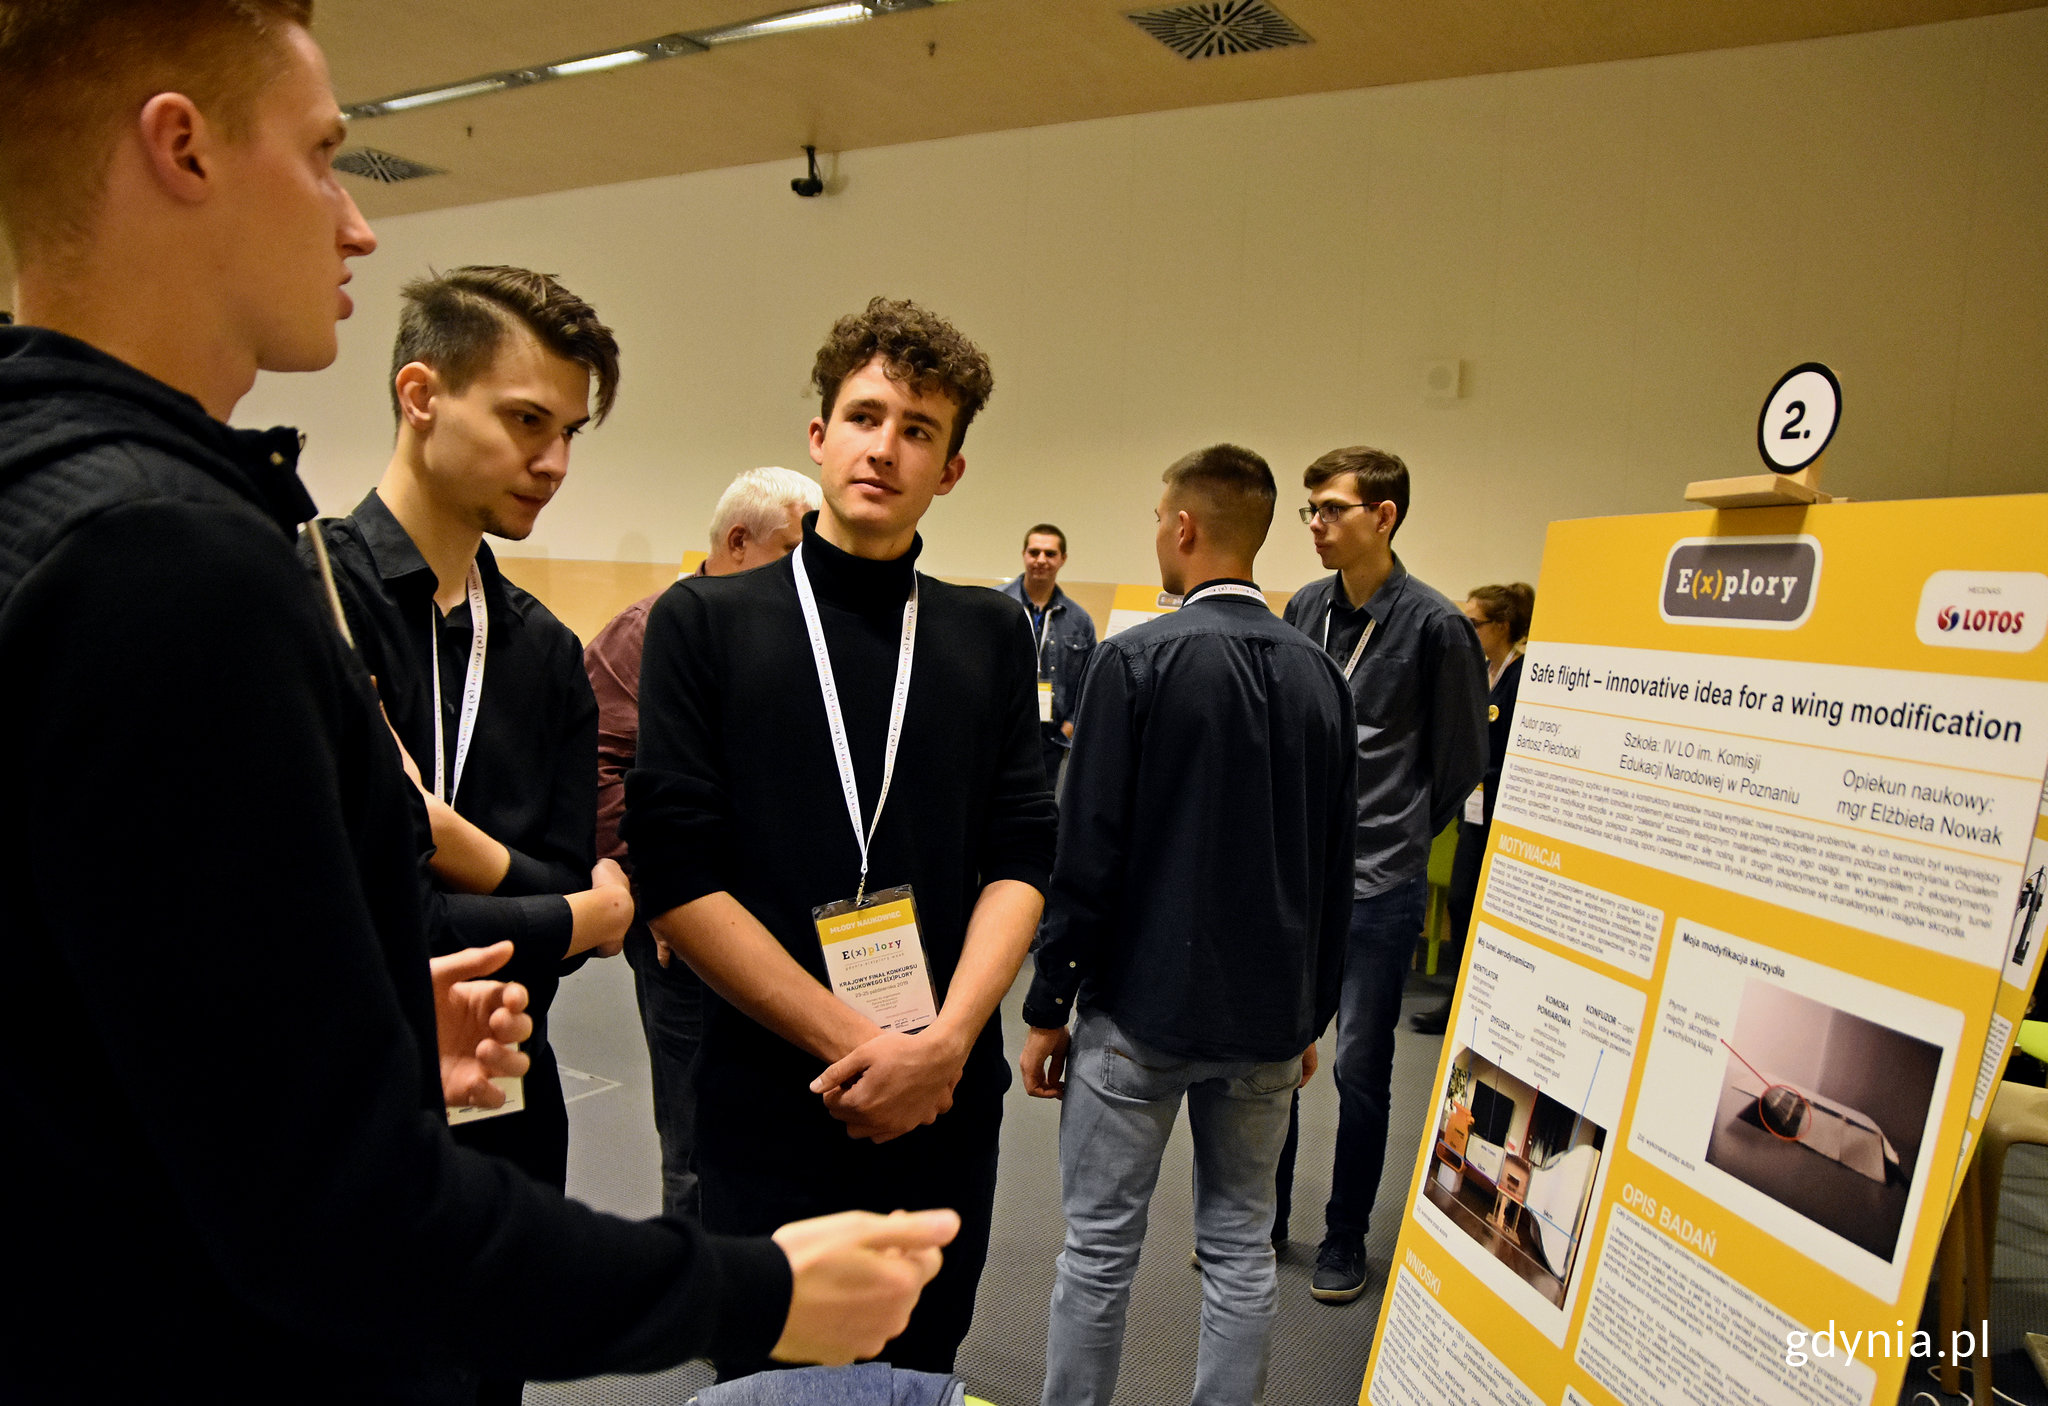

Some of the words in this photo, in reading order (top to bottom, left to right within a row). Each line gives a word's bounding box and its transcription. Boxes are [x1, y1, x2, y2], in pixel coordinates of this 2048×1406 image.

[1780, 400, 1811, 440] 2.
[1676, 568, 1798, 604] E(x)plory
[1962, 609, 2025, 634] LOTOS
[1519, 715, 1539, 730] Autor
[1529, 662, 1556, 683] Safe
[1555, 665, 1591, 692] flight
[1605, 670, 1691, 700] innovative
[1693, 679, 1735, 705] idea
[1736, 684, 1768, 710] for
[1771, 695, 1785, 713] a
[1787, 690, 1845, 726] wing
[1849, 697, 2025, 743] modification
[1515, 734, 1542, 751] Bartosz
[1542, 740, 1581, 759] Piechocki
[1623, 732, 1661, 752] Szkoła:
[1662, 739, 1676, 754] IV
[1676, 741, 1695, 758] LO
[1696, 744, 1715, 761] im.
[1715, 748, 1762, 774] Komisji
[1618, 754, 1663, 779] Edukacji
[1663, 763, 1725, 793] Narodowej
[1726, 780, 1737, 791] w
[1739, 777, 1801, 805] Poznaniu
[1840, 769, 1908, 800] Opiekun
[1910, 781, 1996, 816] naukowy:
[1835, 800, 1866, 822] mgr
[1869, 802, 1936, 832] Elżbieta
[1939, 816, 2004, 846] Nowak
[1497, 834, 1563, 870] MOTYWACJA
[842, 939, 902, 960] E(x)plory
[1620, 1180, 1658, 1220] OPIS
[1658, 1200, 1718, 1258] BADAŃ
[1403, 1246, 1442, 1297] WNIOSKI
